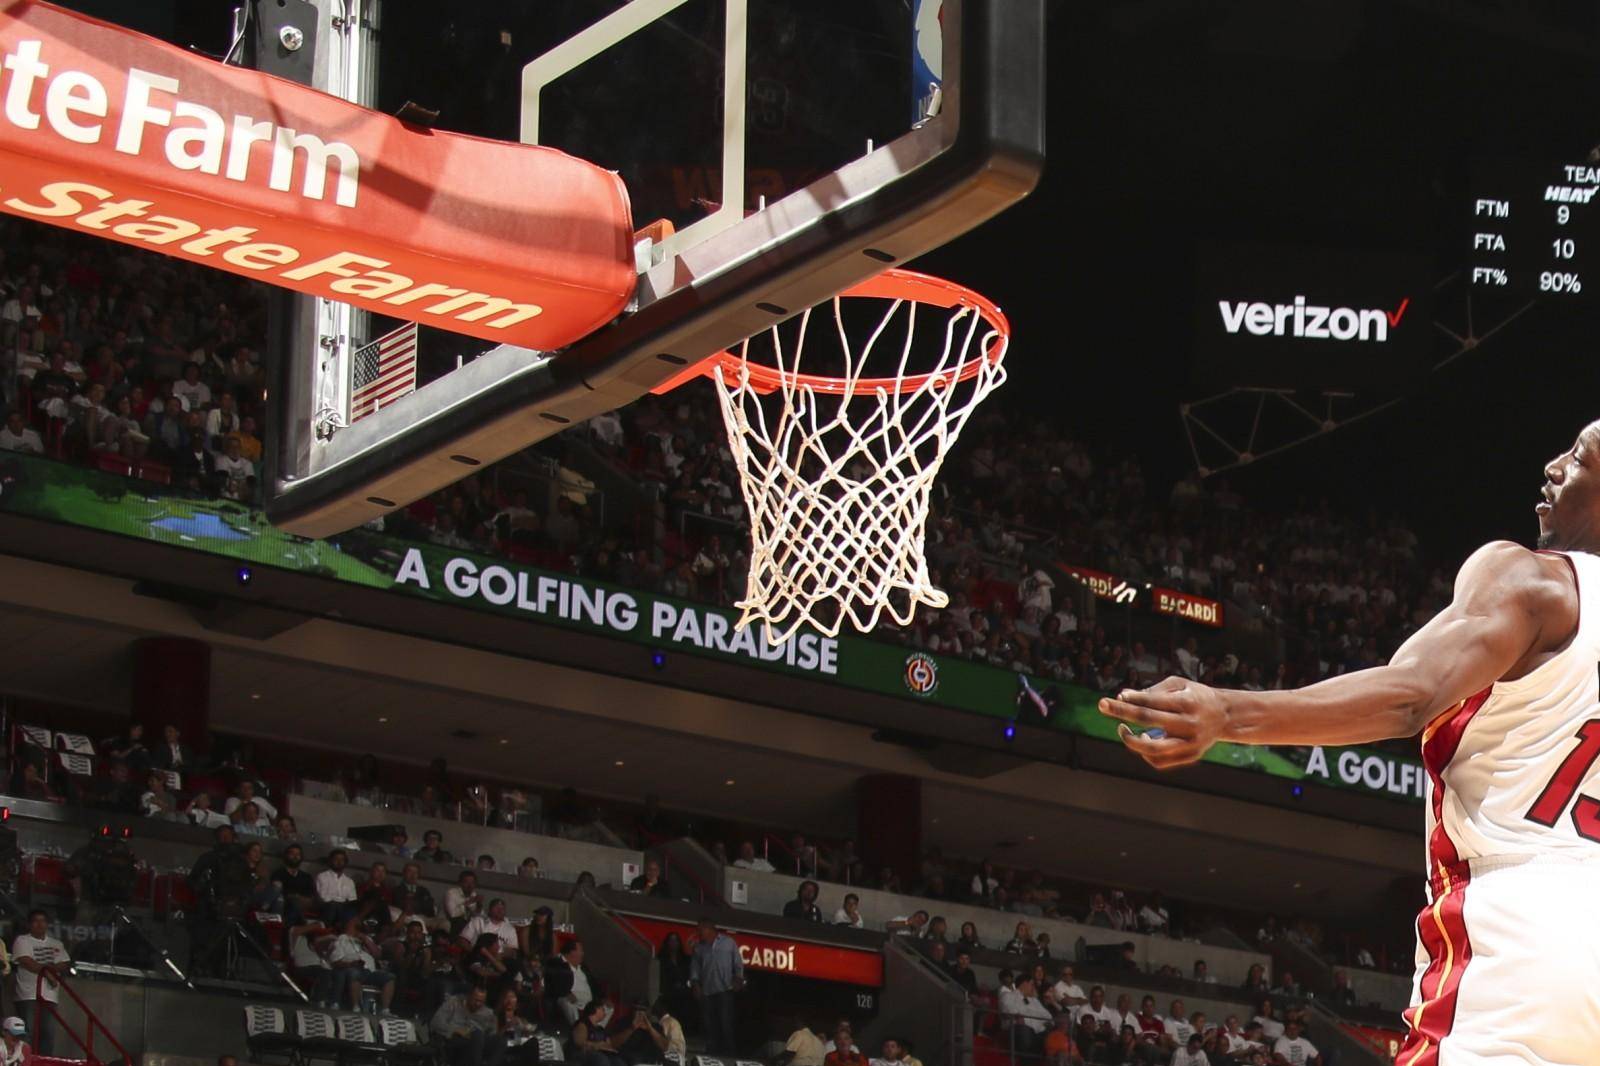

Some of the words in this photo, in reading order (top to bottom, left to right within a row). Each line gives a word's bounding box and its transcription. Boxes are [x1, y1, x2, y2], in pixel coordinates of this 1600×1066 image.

[116, 67, 361, 209] Farm
[1475, 199, 1510, 218] FTM
[1557, 205, 1570, 224] 9
[1544, 185, 1600, 204] HEAT
[5, 181, 300, 270] State
[280, 251, 543, 329] Farm
[1474, 233, 1506, 251] FTA
[1552, 239, 1575, 259] 10
[1473, 267, 1508, 286] FT%
[1539, 271, 1581, 294] 90%
[1219, 296, 1389, 342] verizon
[395, 548, 430, 589] A
[444, 557, 639, 631] GOLFING
[652, 601, 839, 675] PARADISE
[1305, 746, 1329, 778] A
[1338, 751, 1427, 798] GOLFI
[738, 945, 795, 971] CARDÍ
